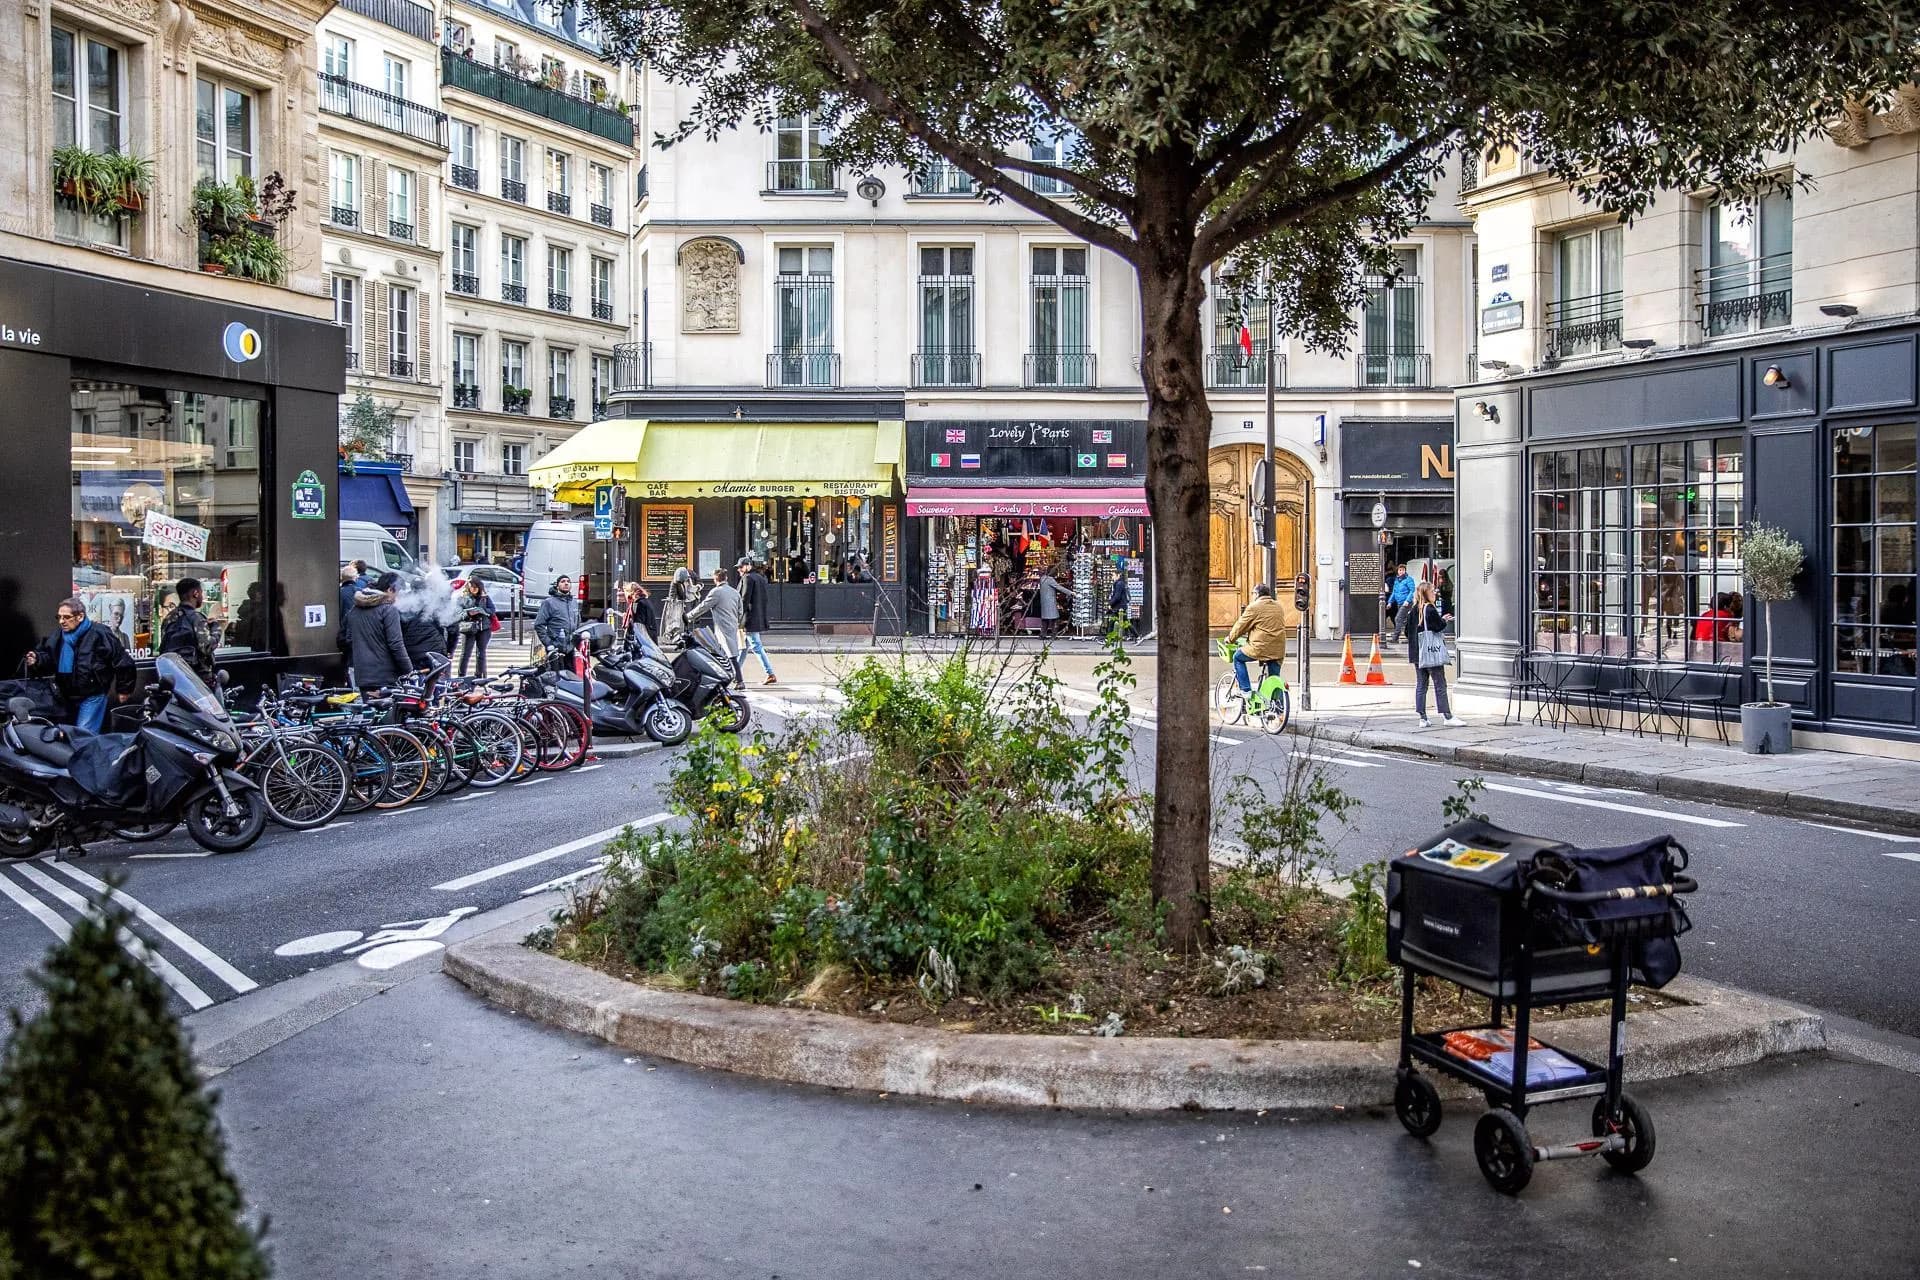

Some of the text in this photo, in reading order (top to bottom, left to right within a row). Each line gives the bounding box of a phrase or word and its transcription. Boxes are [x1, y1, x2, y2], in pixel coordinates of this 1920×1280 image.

[2, 324, 41, 346] la vie
[989, 425, 1069, 443] Lovely Paris
[1421, 444, 1455, 479] N
[713, 482, 795, 493] Mamie BURGER
[823, 482, 879, 490] RESTAURANT
[599, 490, 608, 511] P
[916, 504, 1144, 514] Souvenirs Lovely Paris Cadeaux
[1427, 645, 1441, 653] HAY
